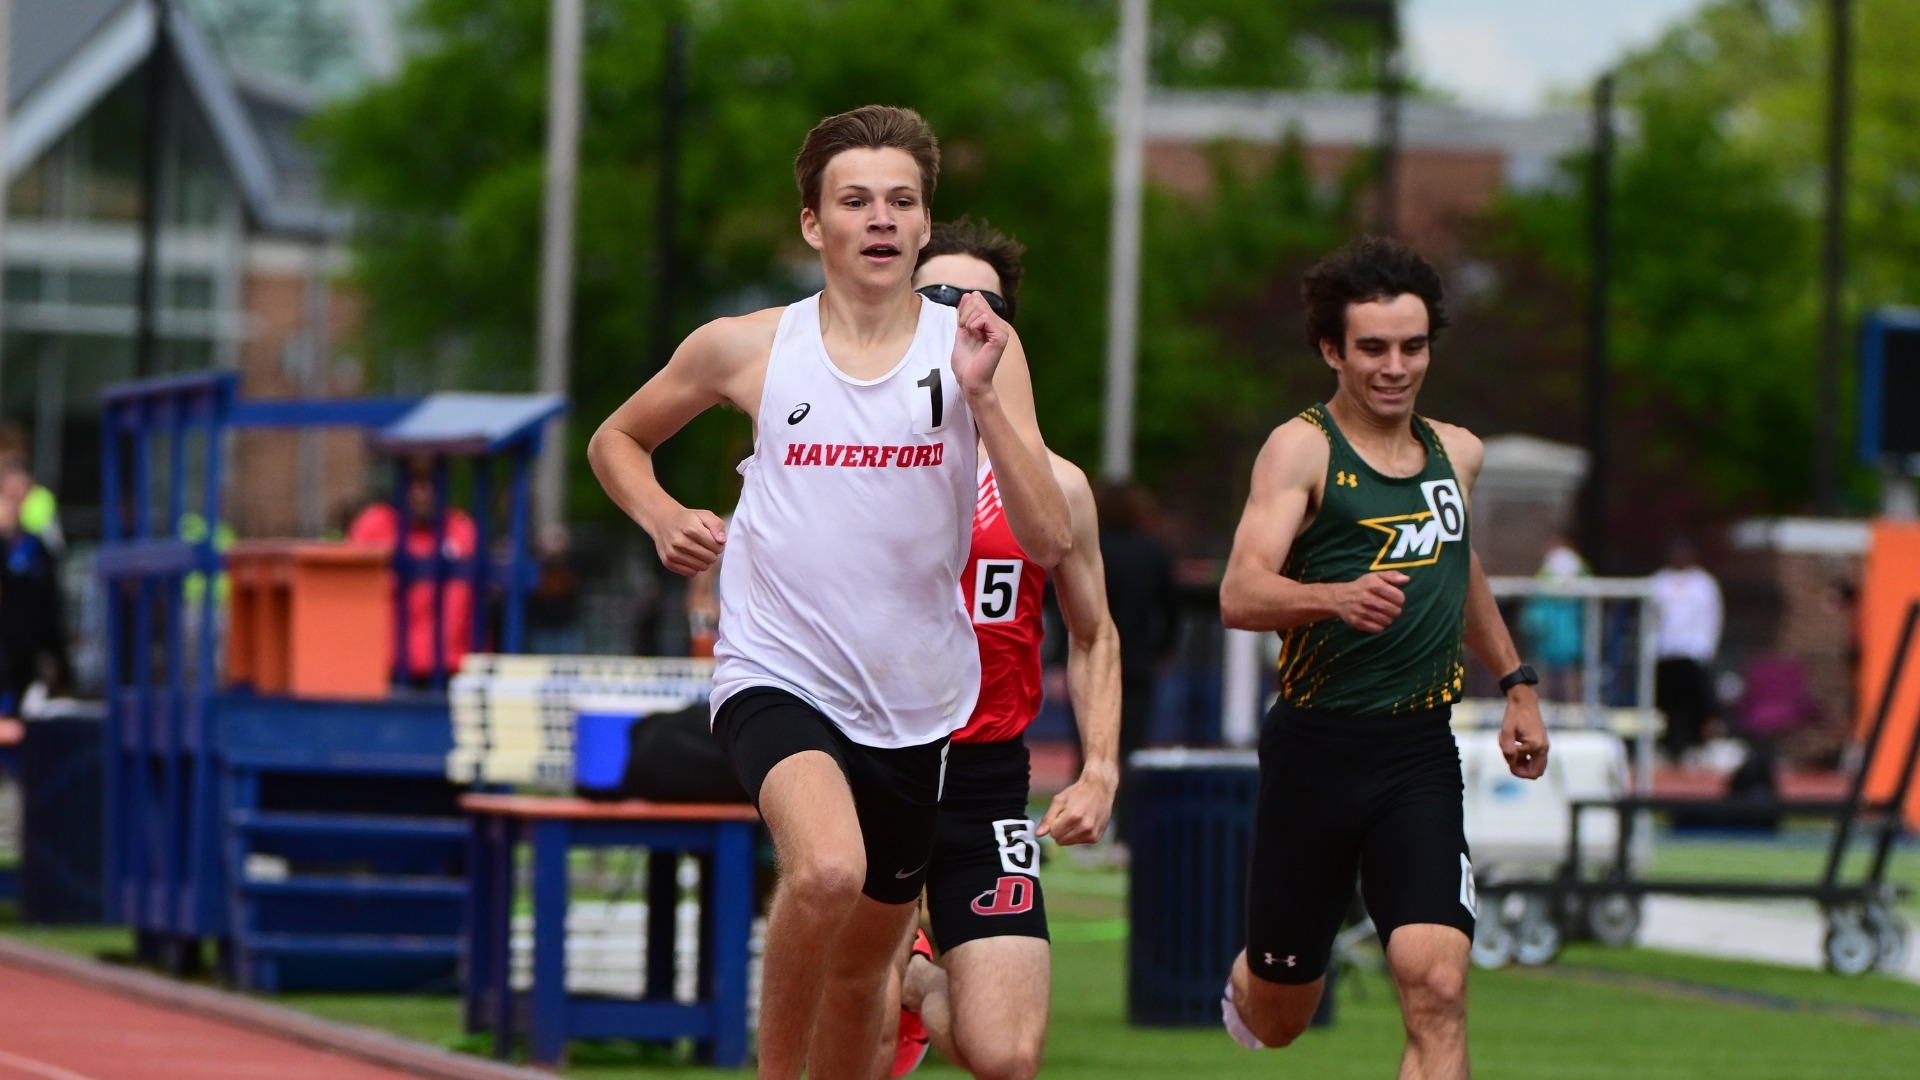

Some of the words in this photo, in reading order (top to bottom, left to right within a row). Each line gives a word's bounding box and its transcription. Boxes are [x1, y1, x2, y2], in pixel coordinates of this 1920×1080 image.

[917, 368, 943, 428] 1
[784, 442, 944, 468] HAVERFORD
[1433, 485, 1460, 536] 6
[1390, 519, 1440, 559] M
[981, 564, 1015, 619] 5
[1003, 824, 1034, 869] 5
